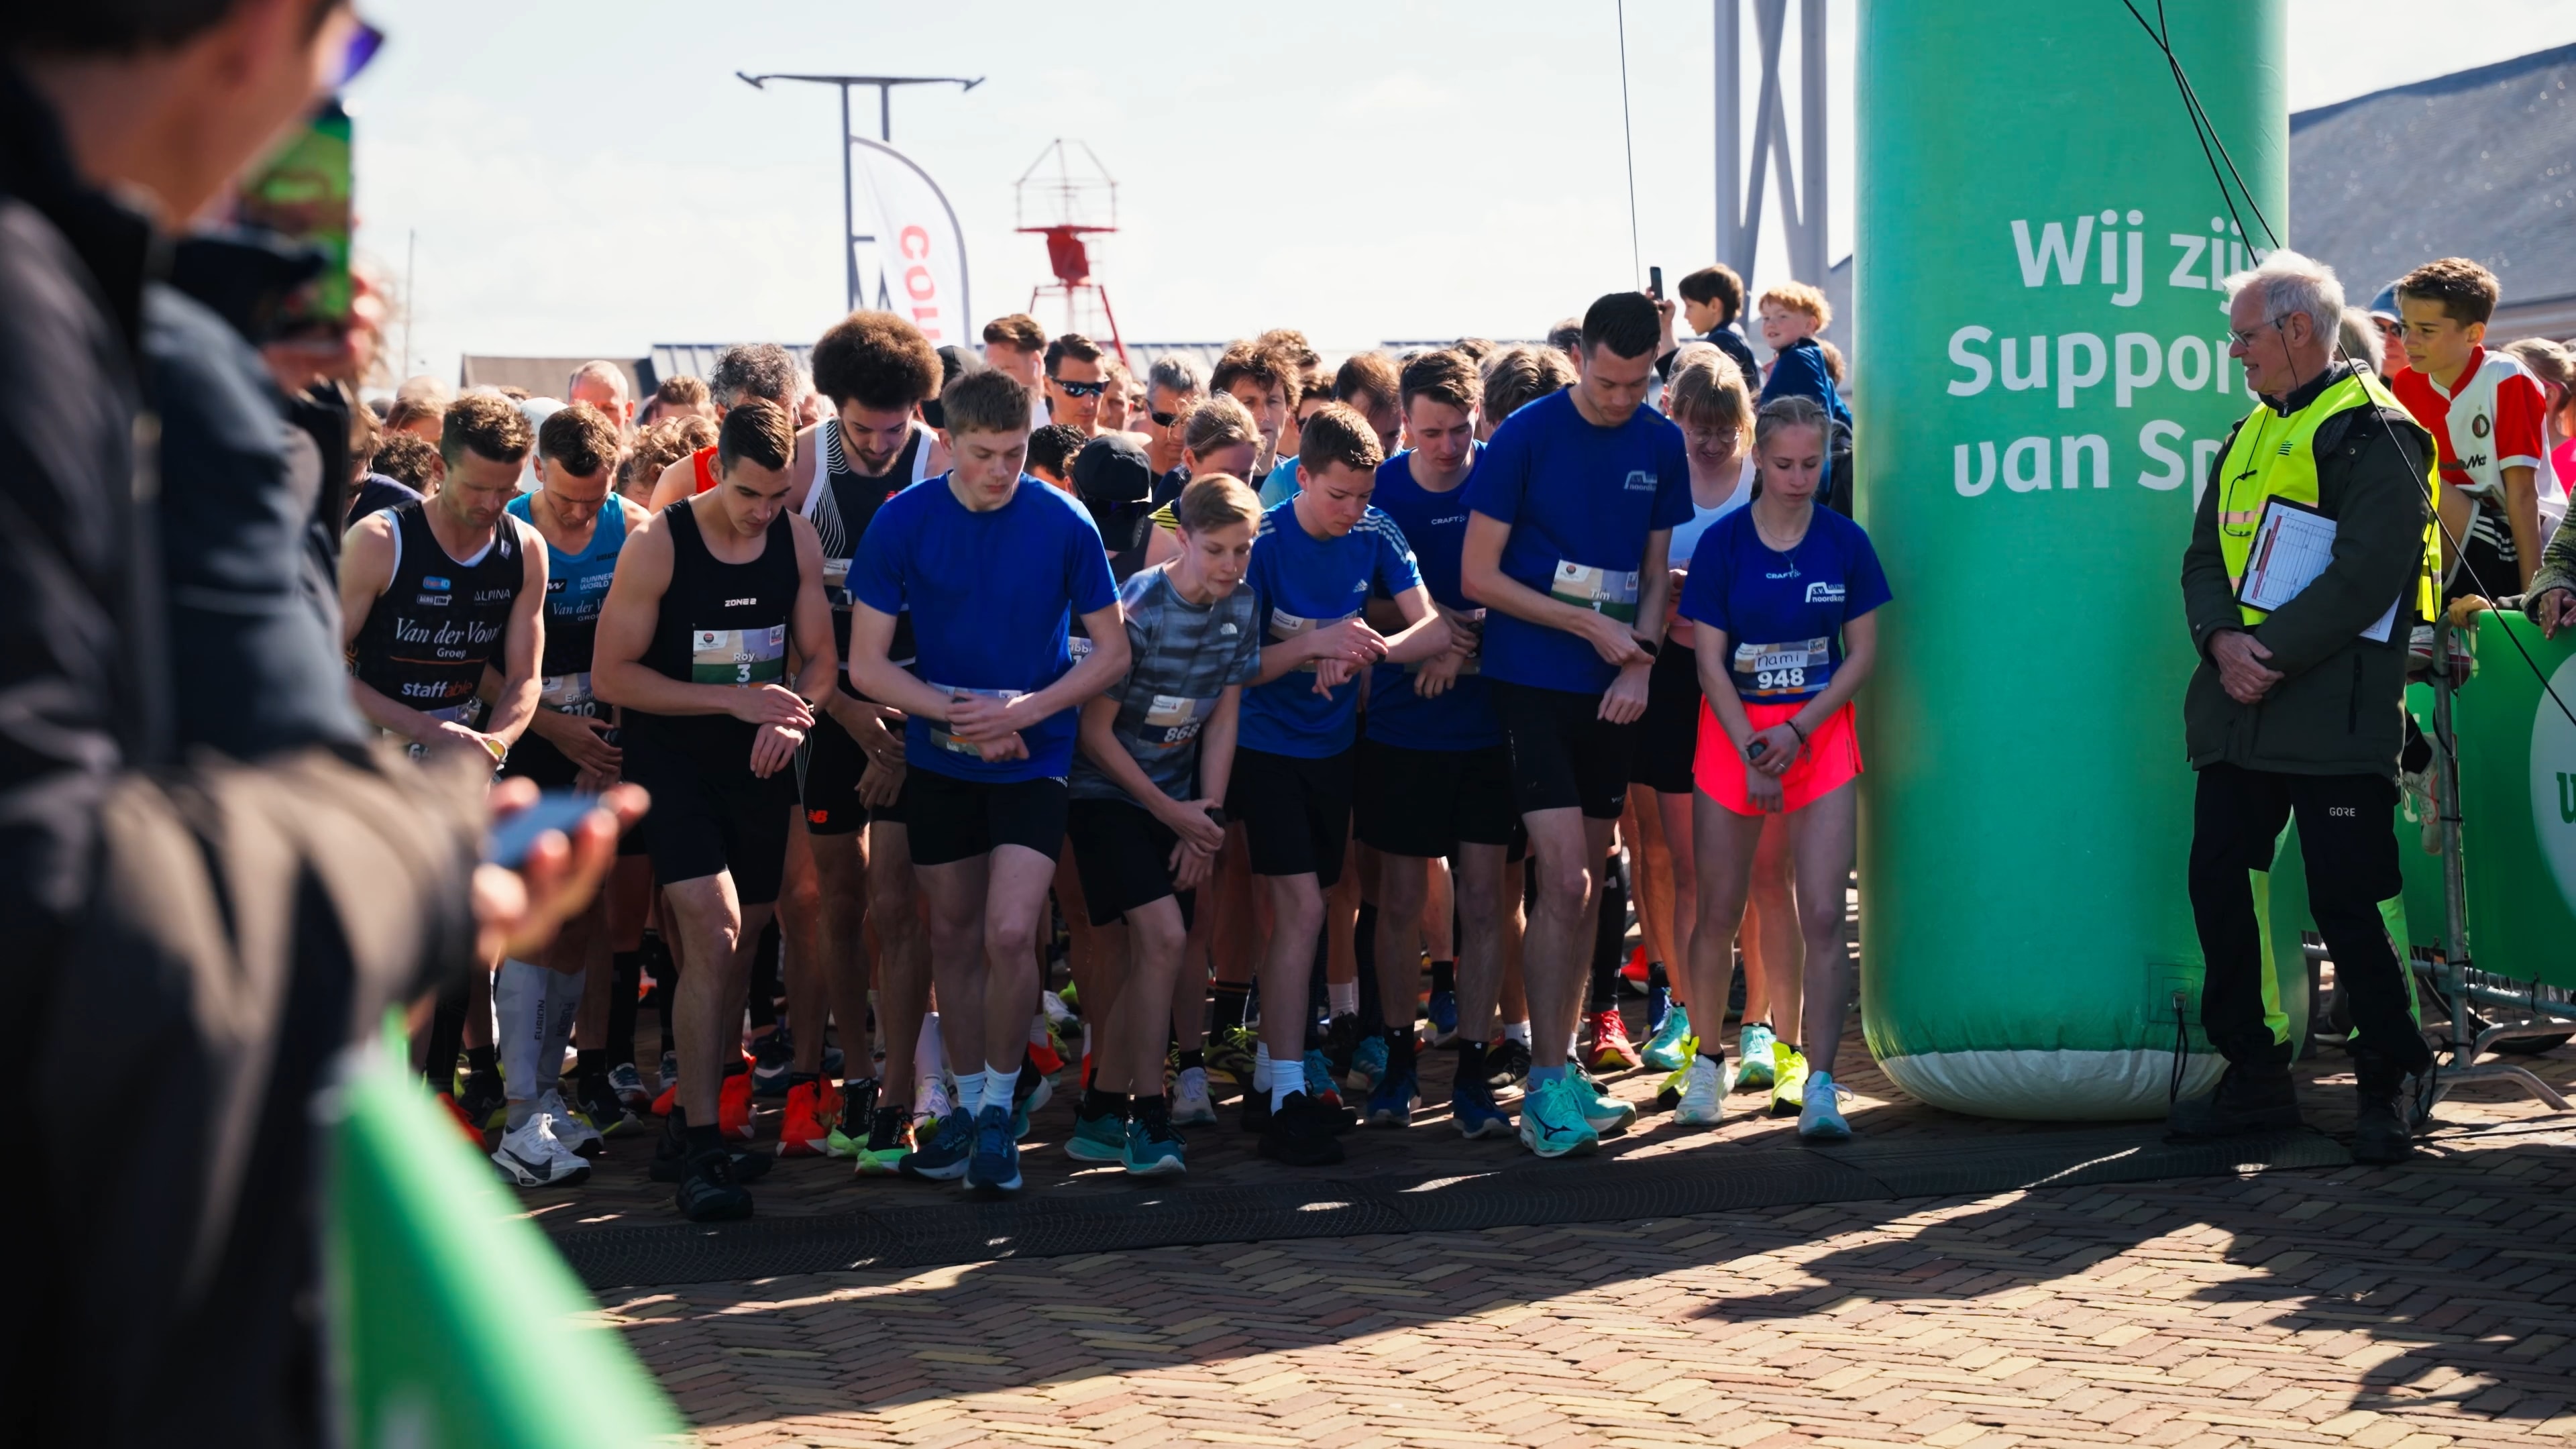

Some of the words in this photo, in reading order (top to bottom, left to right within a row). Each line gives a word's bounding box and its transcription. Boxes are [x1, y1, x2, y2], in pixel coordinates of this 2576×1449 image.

[2010, 209, 2143, 307] Wij
[1954, 433, 2109, 497] van
[1431, 516, 1458, 525] CRAFT
[580, 580, 609, 590] WORLD
[474, 589, 511, 601] ALPINA
[1591, 588, 1610, 601] Tim
[553, 602, 572, 615] Van
[576, 600, 593, 614] der
[395, 617, 428, 643] Van
[433, 621, 465, 645] der
[437, 647, 466, 659] Groep
[733, 652, 755, 661] Roy
[735, 663, 751, 683] 3
[1758, 667, 1805, 690] 948
[401, 680, 473, 698] staffable
[1164, 722, 1201, 743] 868
[2329, 806, 2356, 817] GORE
[534, 999, 545, 1040] FUSION
